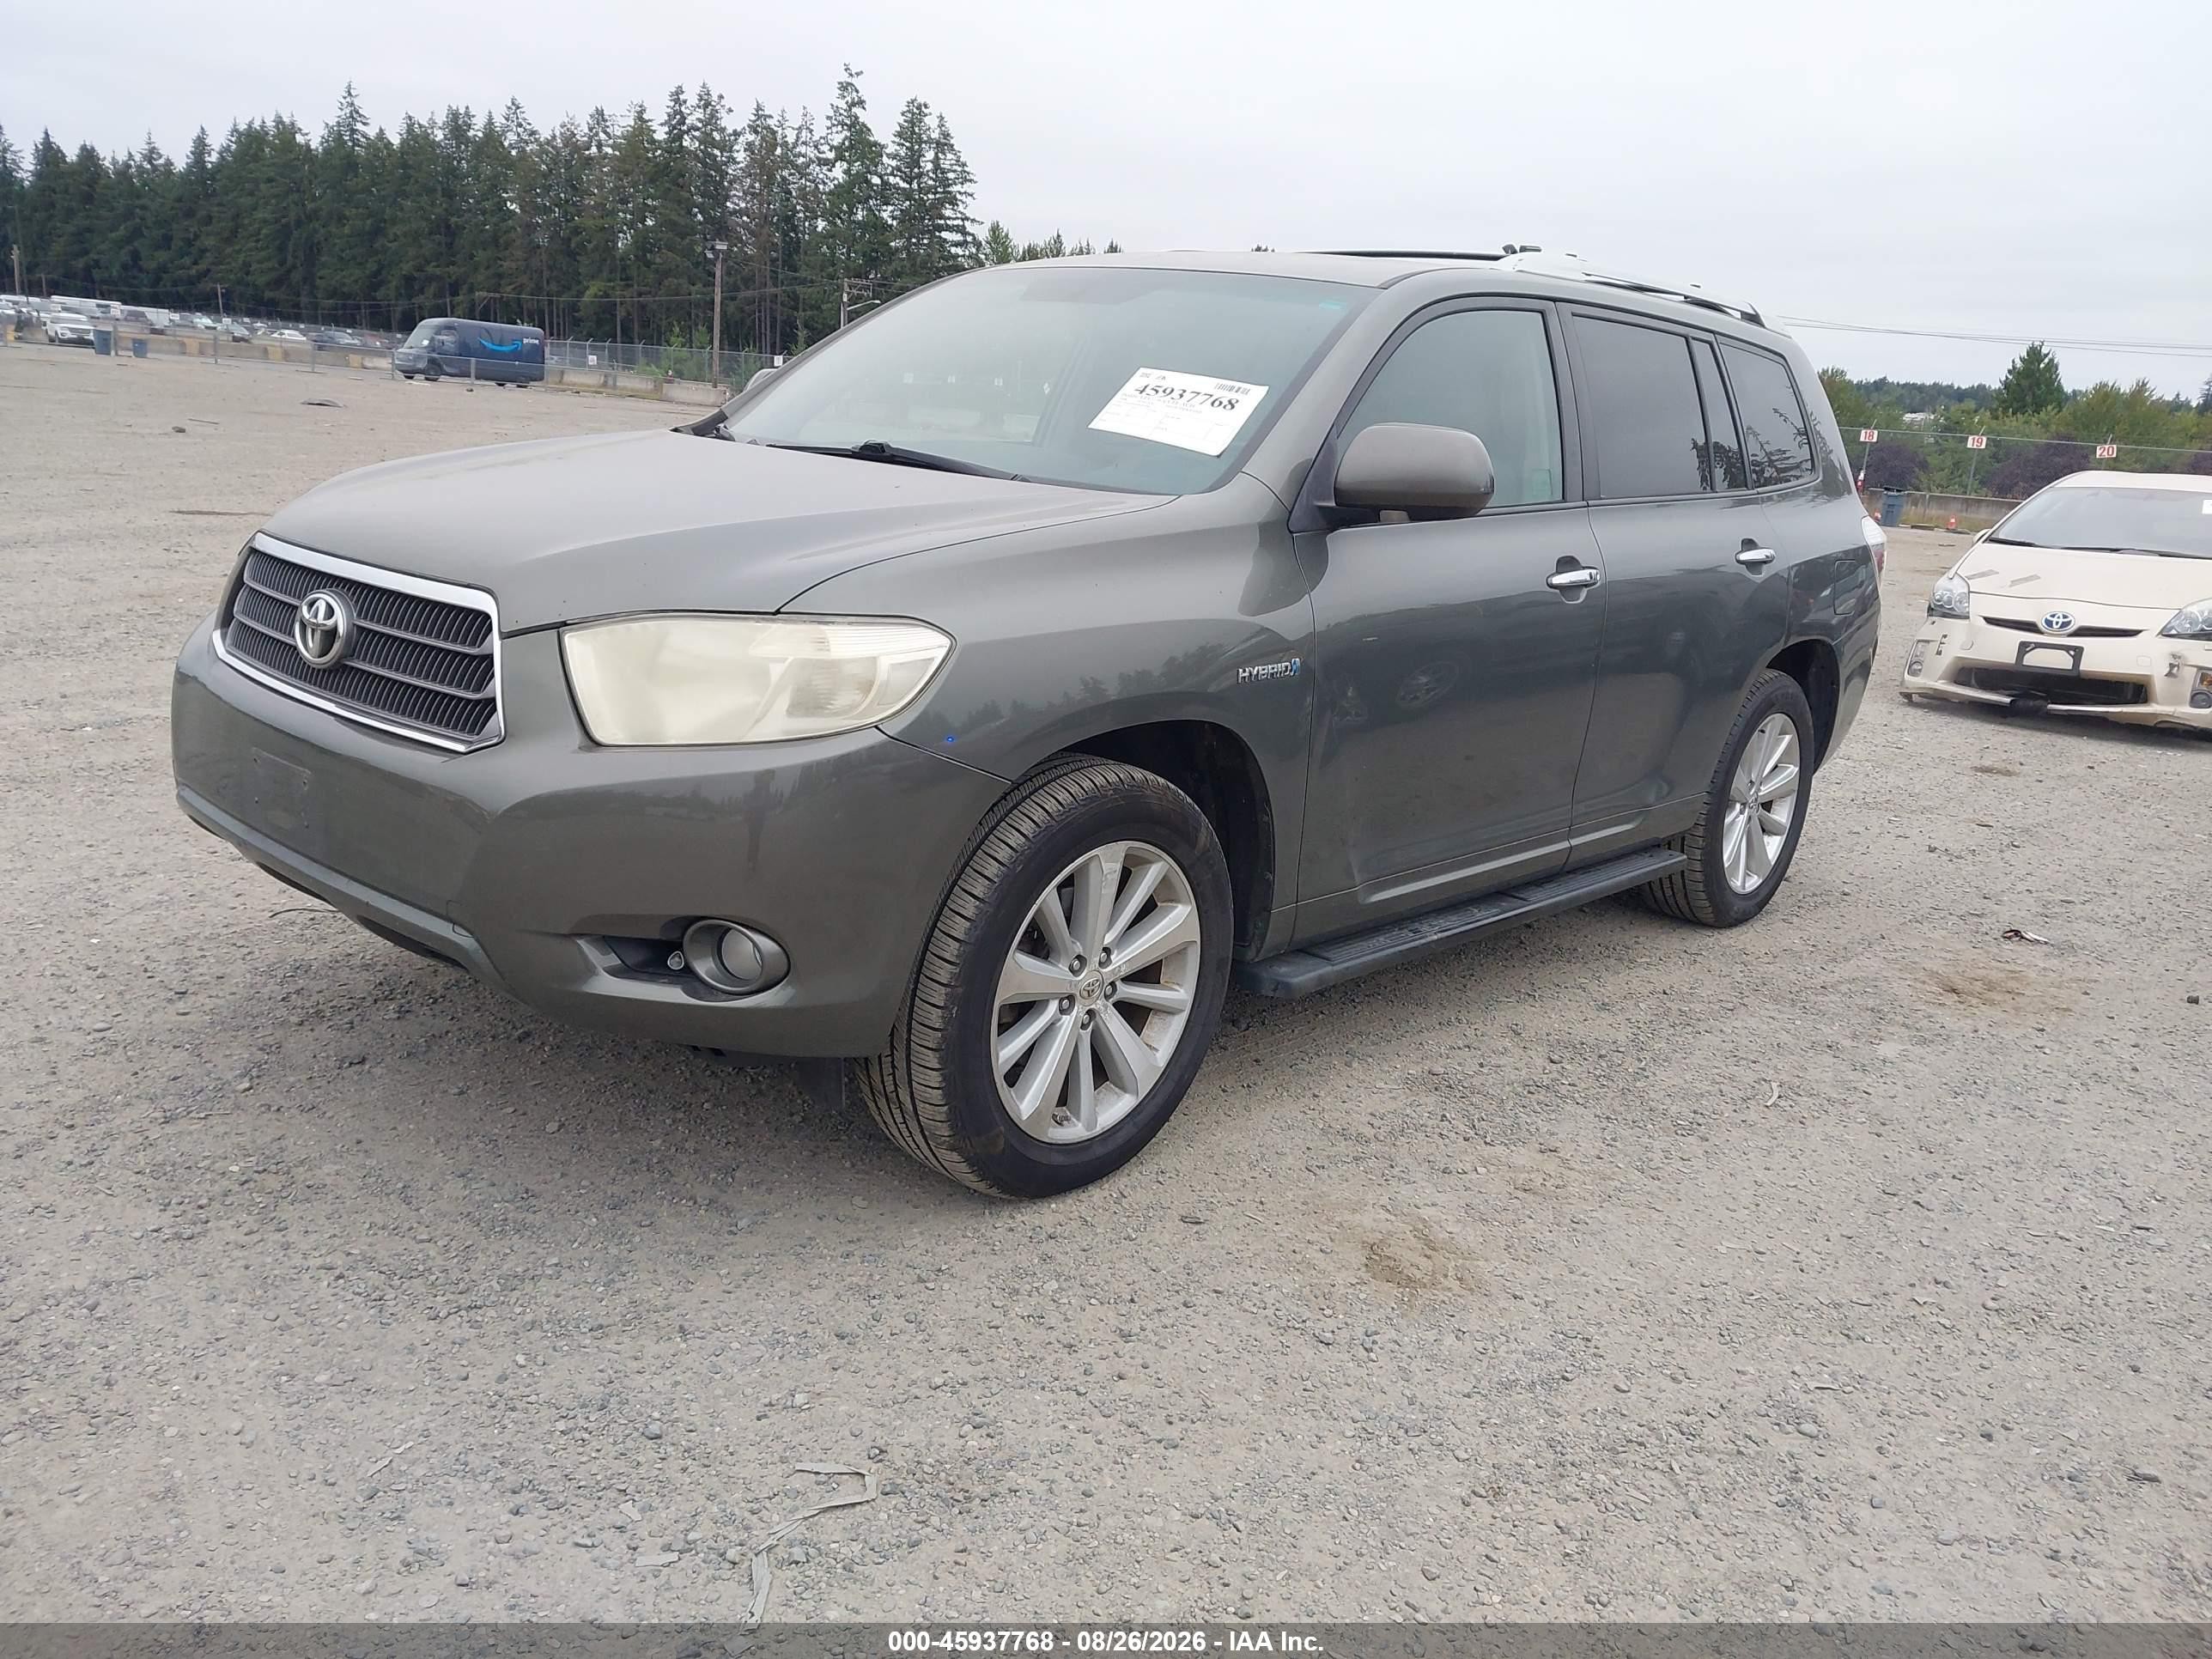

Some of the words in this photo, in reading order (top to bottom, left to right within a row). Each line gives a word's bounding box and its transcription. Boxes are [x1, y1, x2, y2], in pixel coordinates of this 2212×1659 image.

[1133, 383, 1240, 411] 45937768
[1863, 430, 1875, 441] 18
[1969, 436, 1984, 447] 19
[2098, 446, 2115, 457] 20
[1237, 662, 1291, 684] HYBRID
